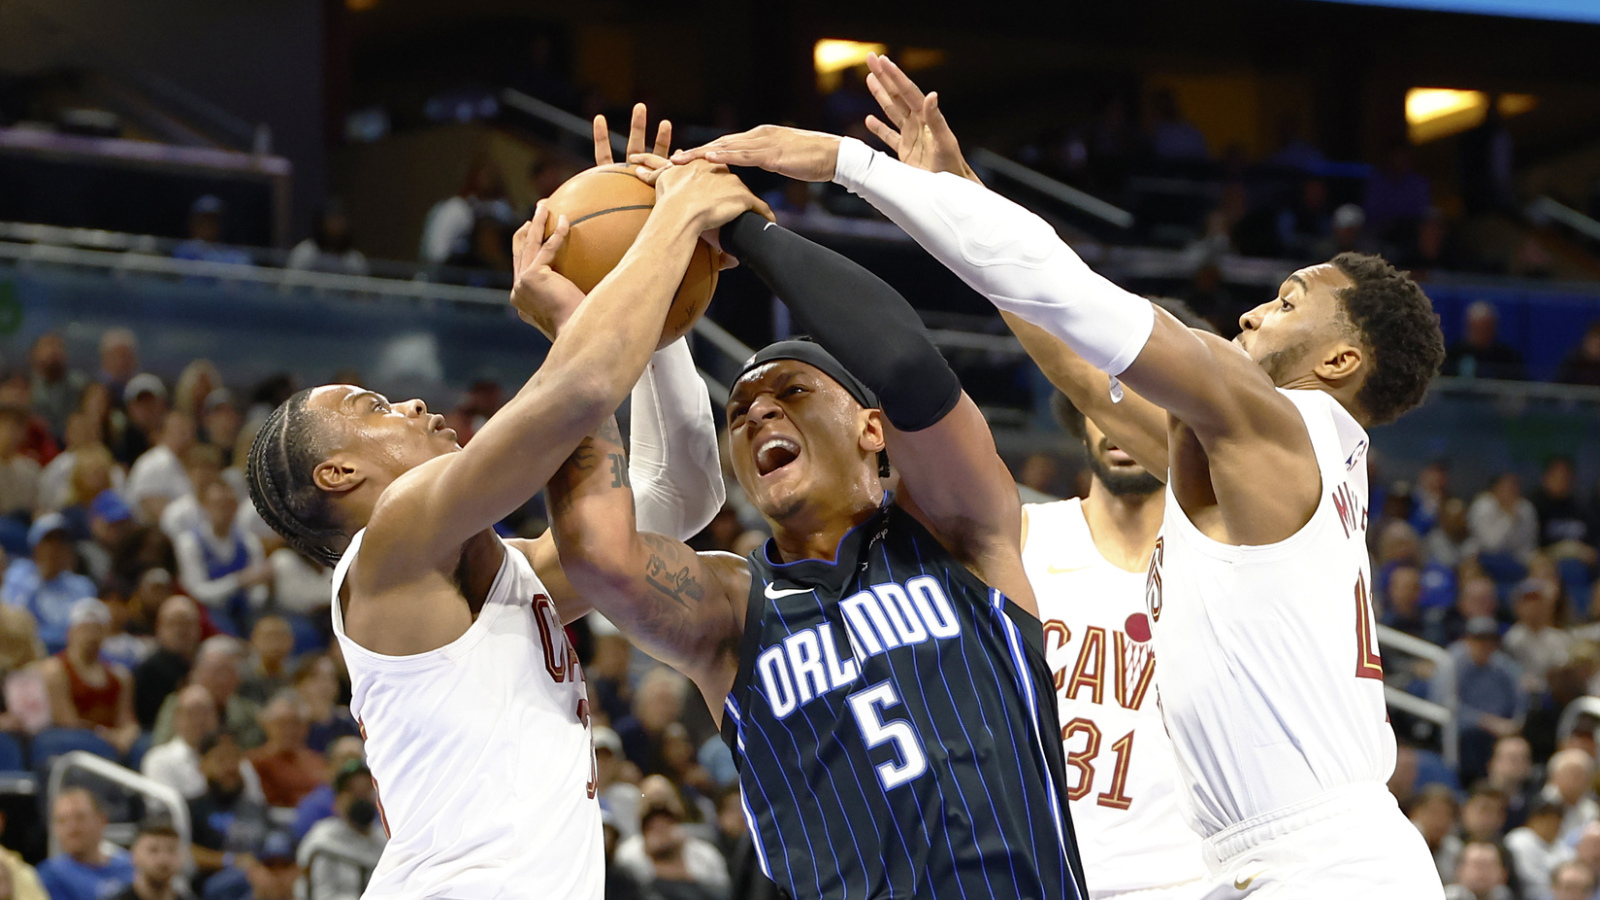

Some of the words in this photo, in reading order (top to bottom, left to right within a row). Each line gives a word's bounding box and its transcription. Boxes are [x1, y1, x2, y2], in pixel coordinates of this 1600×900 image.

[756, 574, 961, 721] ORLANDO
[845, 677, 928, 792] 5
[1061, 717, 1135, 810] 31
